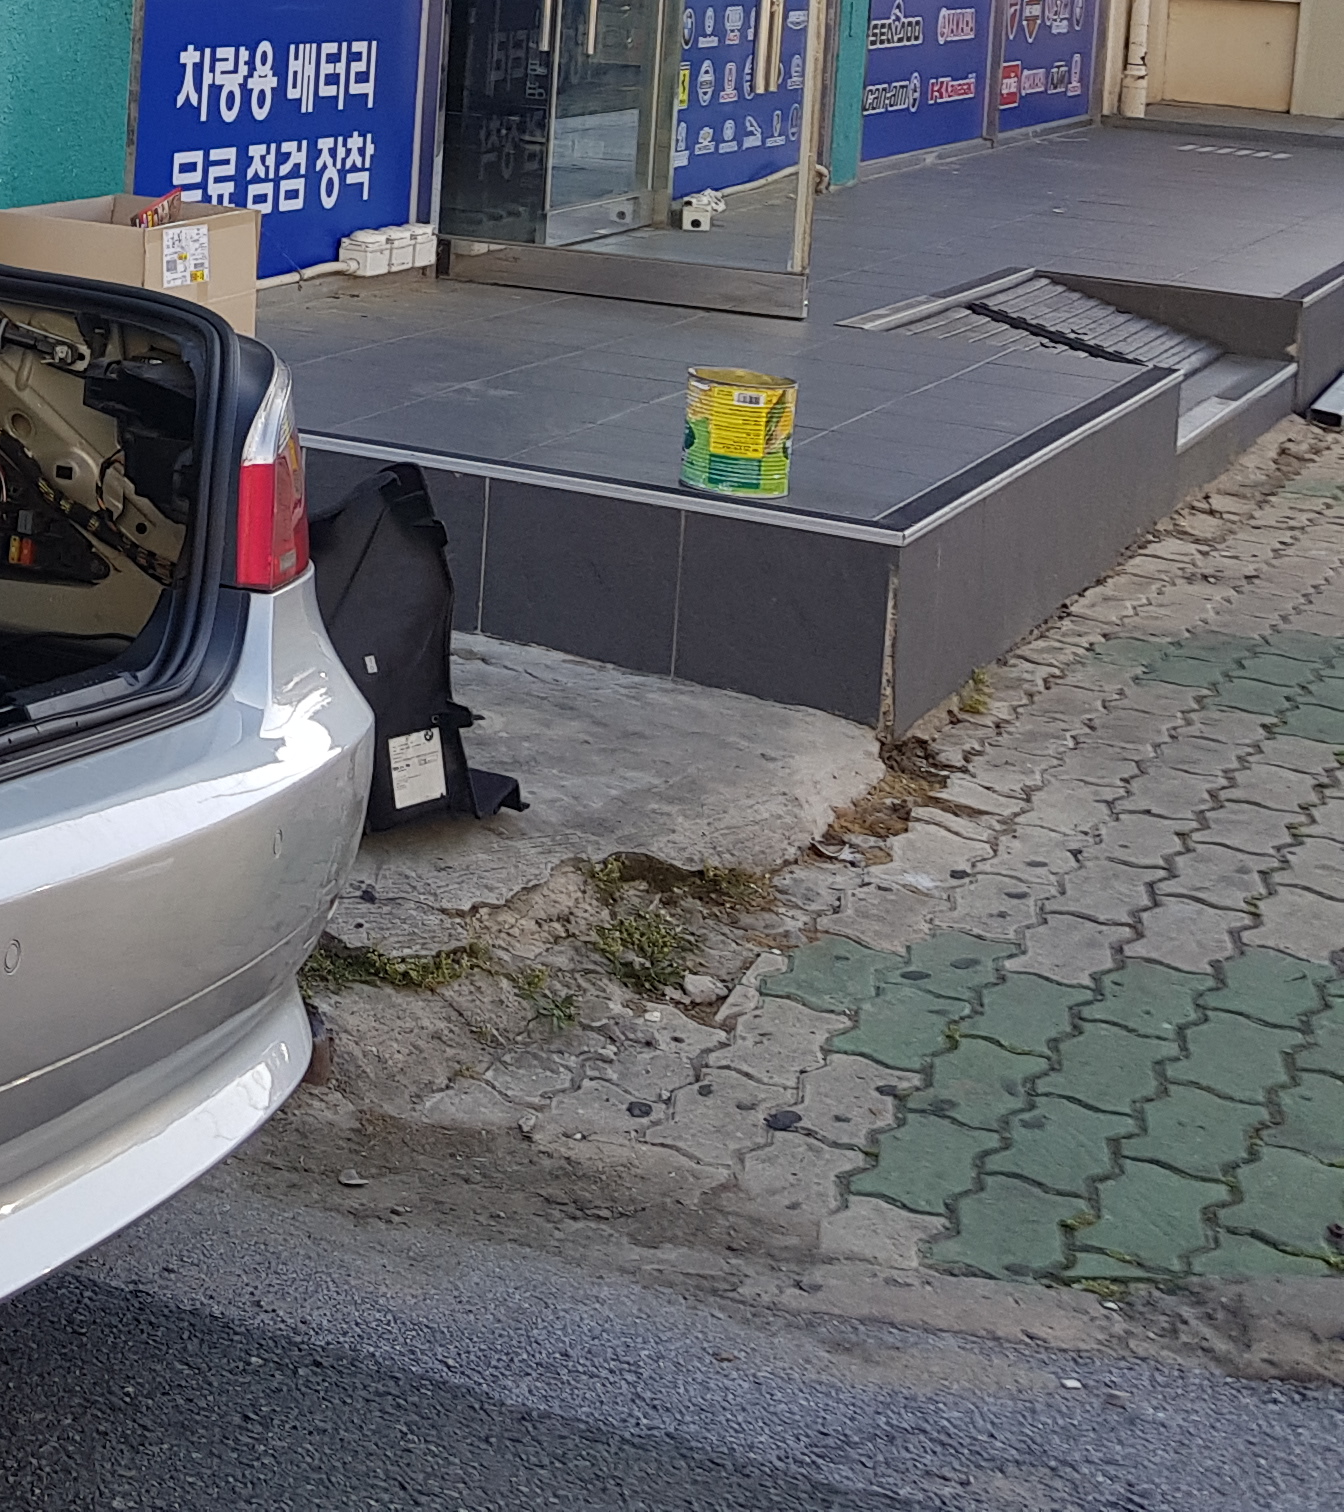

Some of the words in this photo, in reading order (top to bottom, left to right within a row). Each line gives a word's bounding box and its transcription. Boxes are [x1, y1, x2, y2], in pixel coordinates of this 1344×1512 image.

[176, 39, 278, 123] 차량용
[286, 38, 378, 115] 배터리
[246, 139, 309, 215] 점검
[315, 129, 376, 211] 장착
